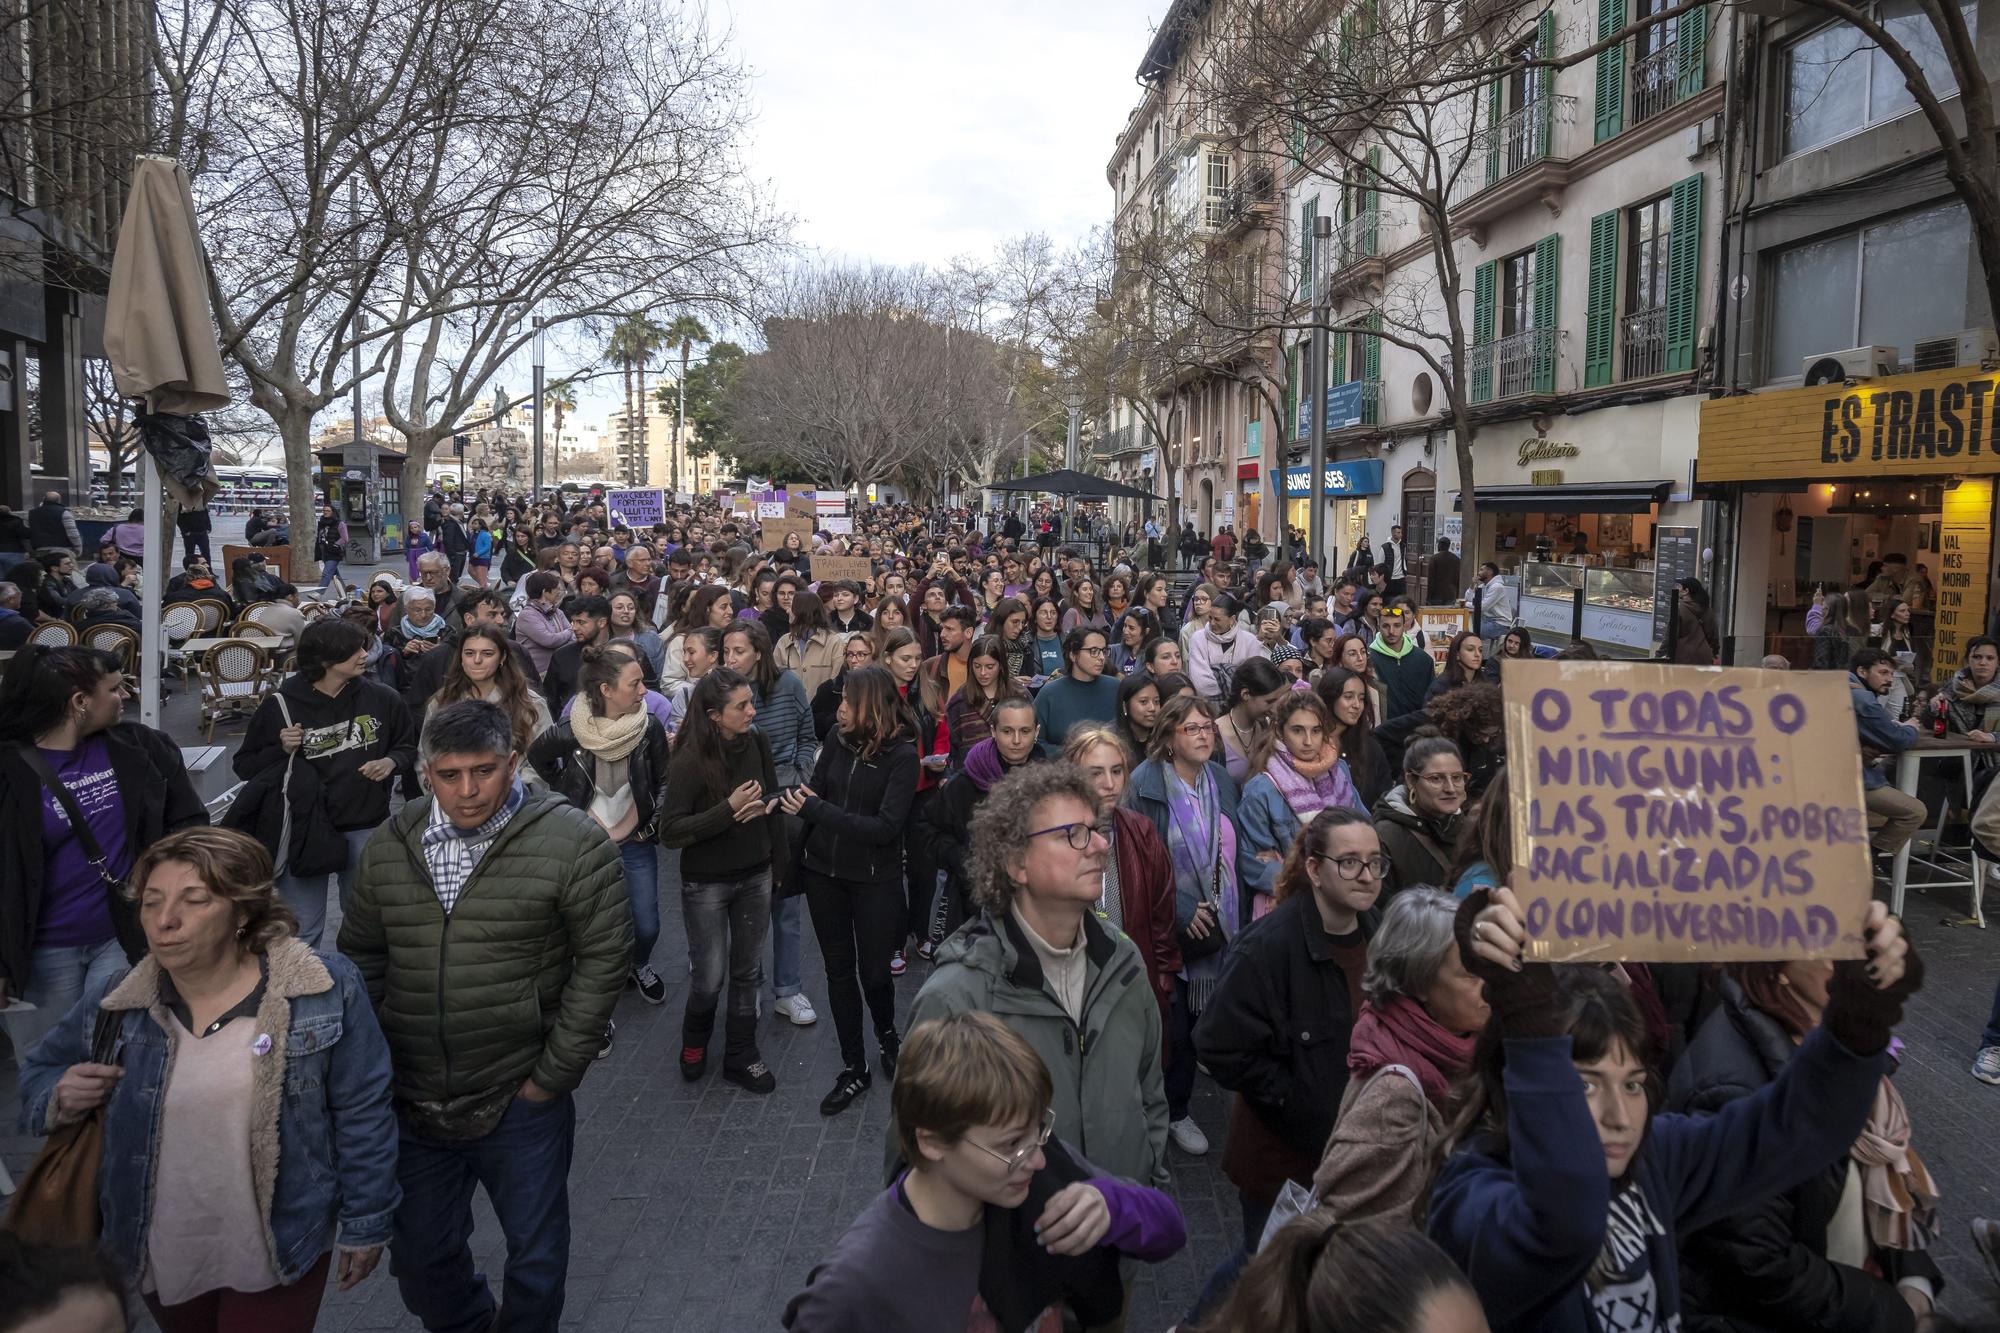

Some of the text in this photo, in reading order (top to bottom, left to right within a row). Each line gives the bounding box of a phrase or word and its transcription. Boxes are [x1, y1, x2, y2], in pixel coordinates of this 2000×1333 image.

[1821, 394, 1862, 464] ES
[1287, 470, 1346, 490] SUNGSES
[1944, 535, 1960, 550] VAL
[1942, 573, 1970, 588] MORIR
[1941, 592, 1962, 607] D'UN
[1940, 610, 1959, 625] ROT
[1939, 630, 1956, 646] QUE
[1937, 650, 1959, 665] D'UN
[1531, 685, 1806, 738] O TODAS O
[1530, 795, 1607, 842] LAS
